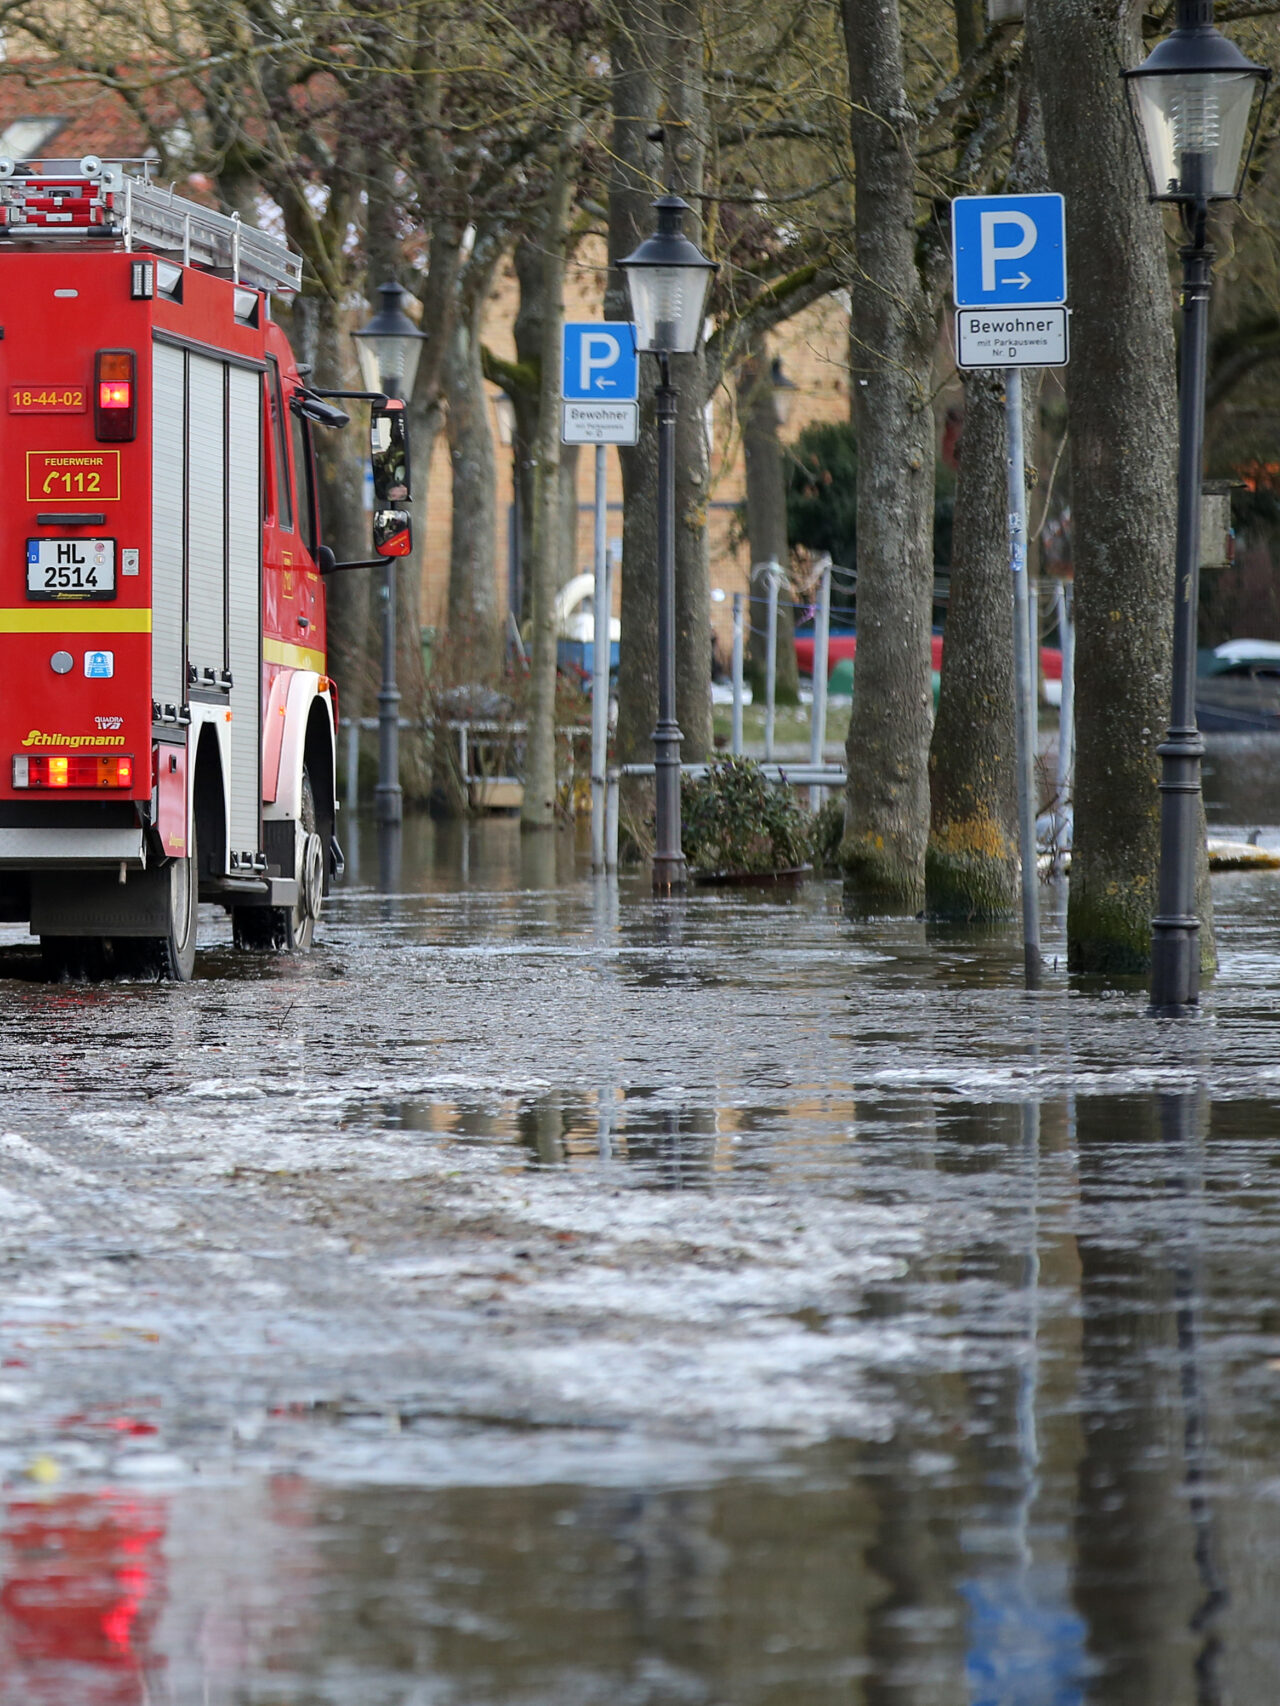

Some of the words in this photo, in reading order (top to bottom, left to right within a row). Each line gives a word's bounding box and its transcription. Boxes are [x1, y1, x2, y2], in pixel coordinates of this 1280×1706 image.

[980, 210, 1038, 292] P
[970, 318, 1054, 334] Bewohner
[977, 338, 991, 347] mit
[994, 337, 1048, 347] Parkausweis
[580, 332, 620, 390] P
[1008, 347, 1017, 358] D
[13, 392, 82, 406] 18-44-02
[570, 408, 629, 420] Bewohner
[44, 457, 104, 466] FEUERWEHR
[61, 472, 101, 492] 112
[57, 543, 86, 564] HL
[44, 566, 98, 588] 2514
[21, 729, 126, 748] Schlingmann
